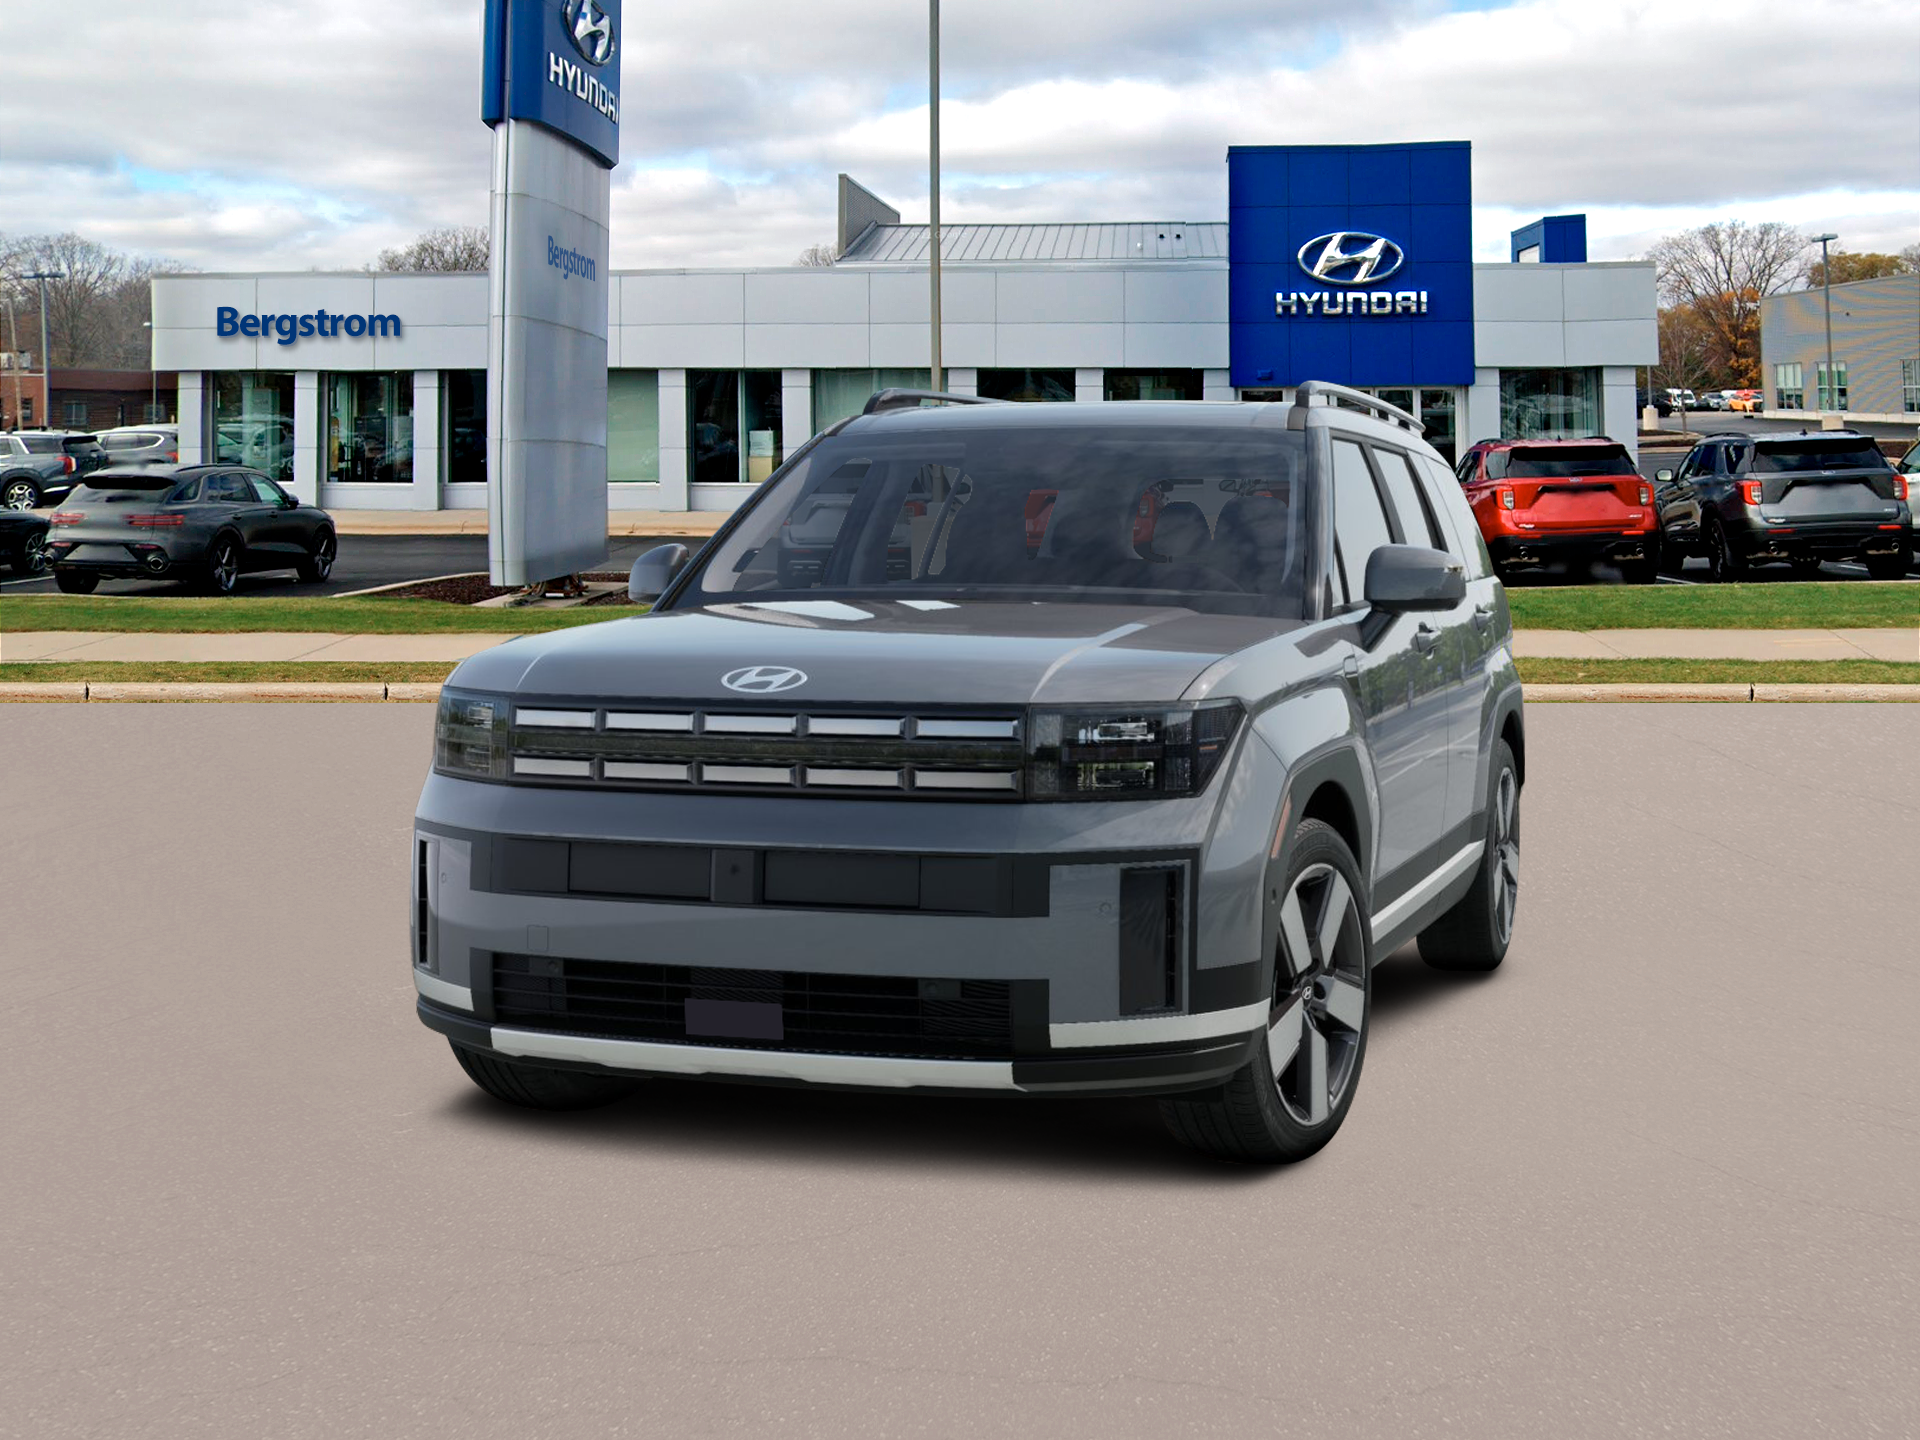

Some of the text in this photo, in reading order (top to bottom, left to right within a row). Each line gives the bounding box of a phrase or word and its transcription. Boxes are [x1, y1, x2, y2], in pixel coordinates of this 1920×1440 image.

[549, 51, 619, 125] HYUNDAI
[547, 235, 596, 282] Bergstrom
[1275, 290, 1428, 316] HYUNDAI
[216, 306, 402, 346] Bergstrom
